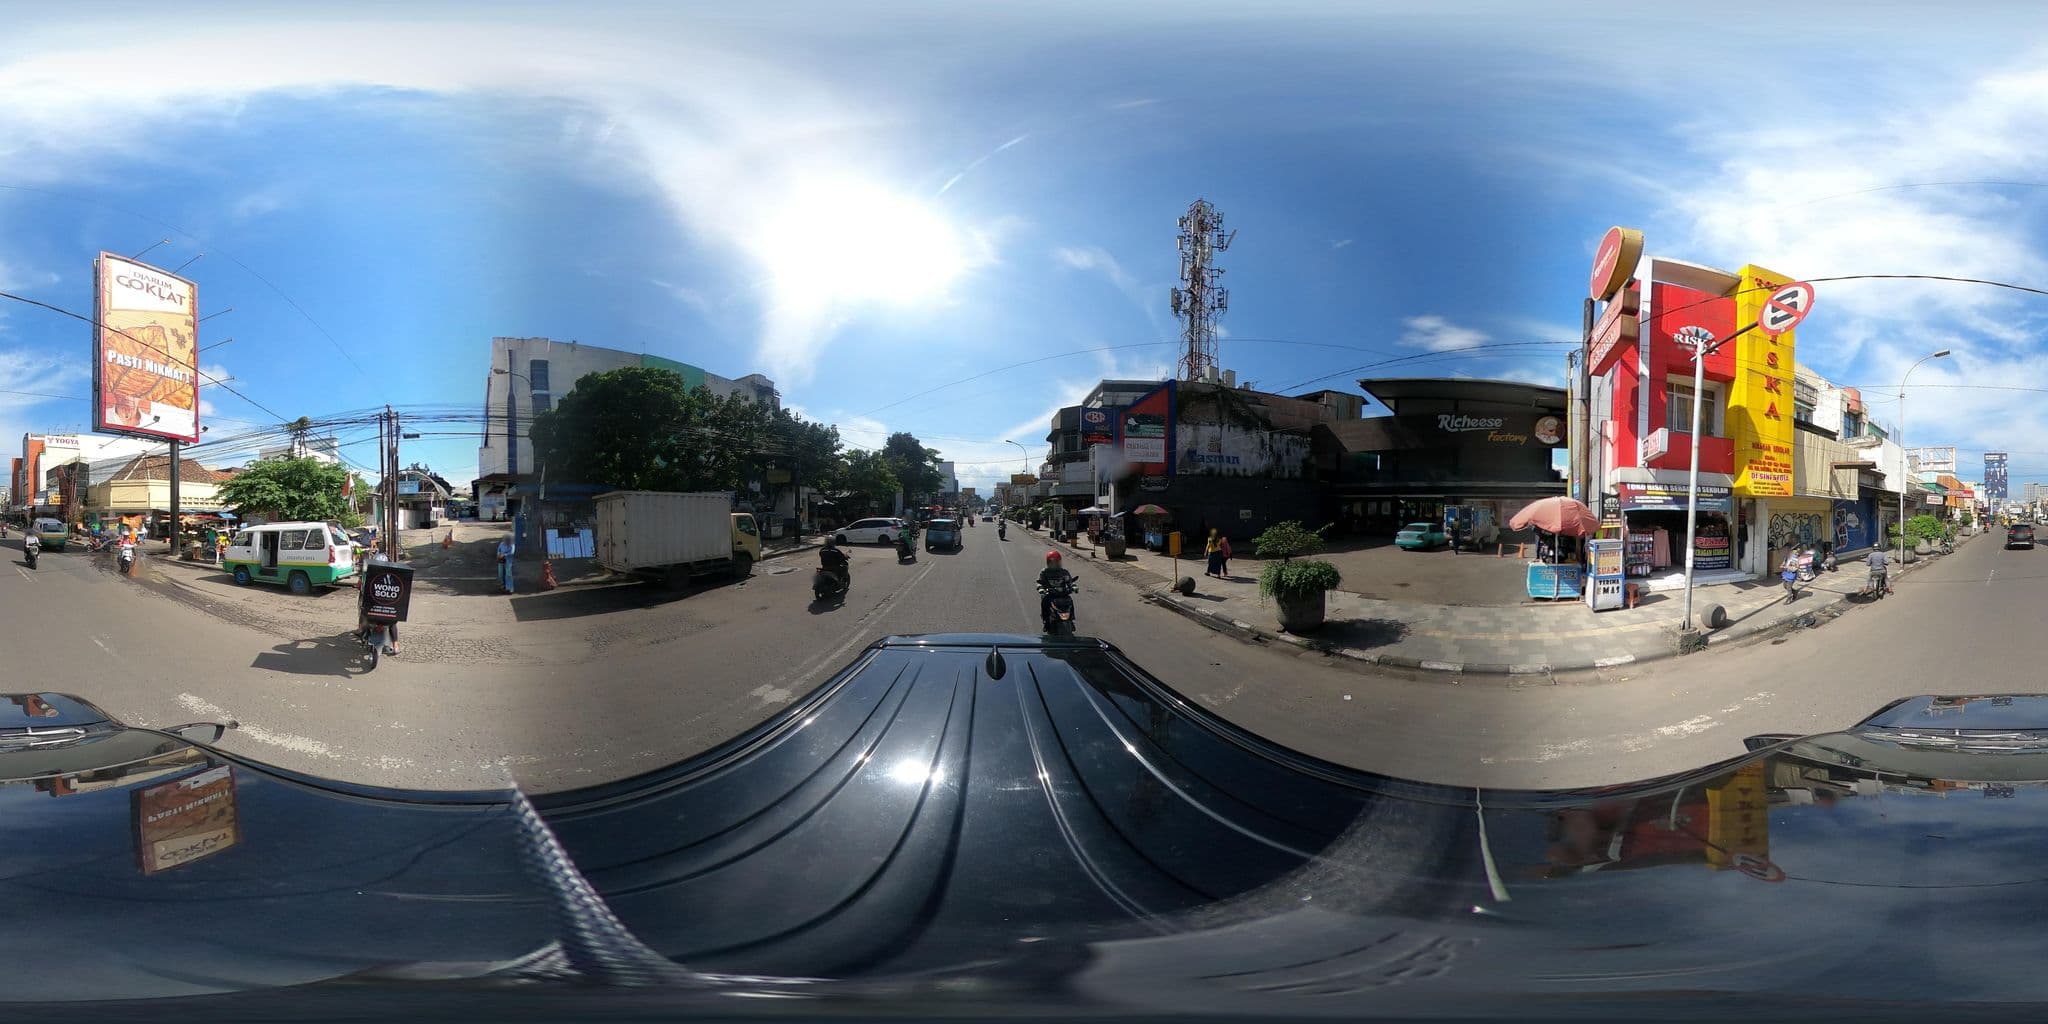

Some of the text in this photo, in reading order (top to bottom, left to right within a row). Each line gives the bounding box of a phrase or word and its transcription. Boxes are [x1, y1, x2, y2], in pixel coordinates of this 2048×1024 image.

[116, 275, 186, 306] COKLAT
[107, 349, 142, 370] PASTI
[145, 362, 183, 382] NIKMAT
[1438, 414, 1503, 432] Richeese
[55, 437, 79, 445] YOGYA
[1487, 431, 1528, 446] Factory
[374, 584, 400, 592] WONG
[375, 590, 397, 599] SOLO
